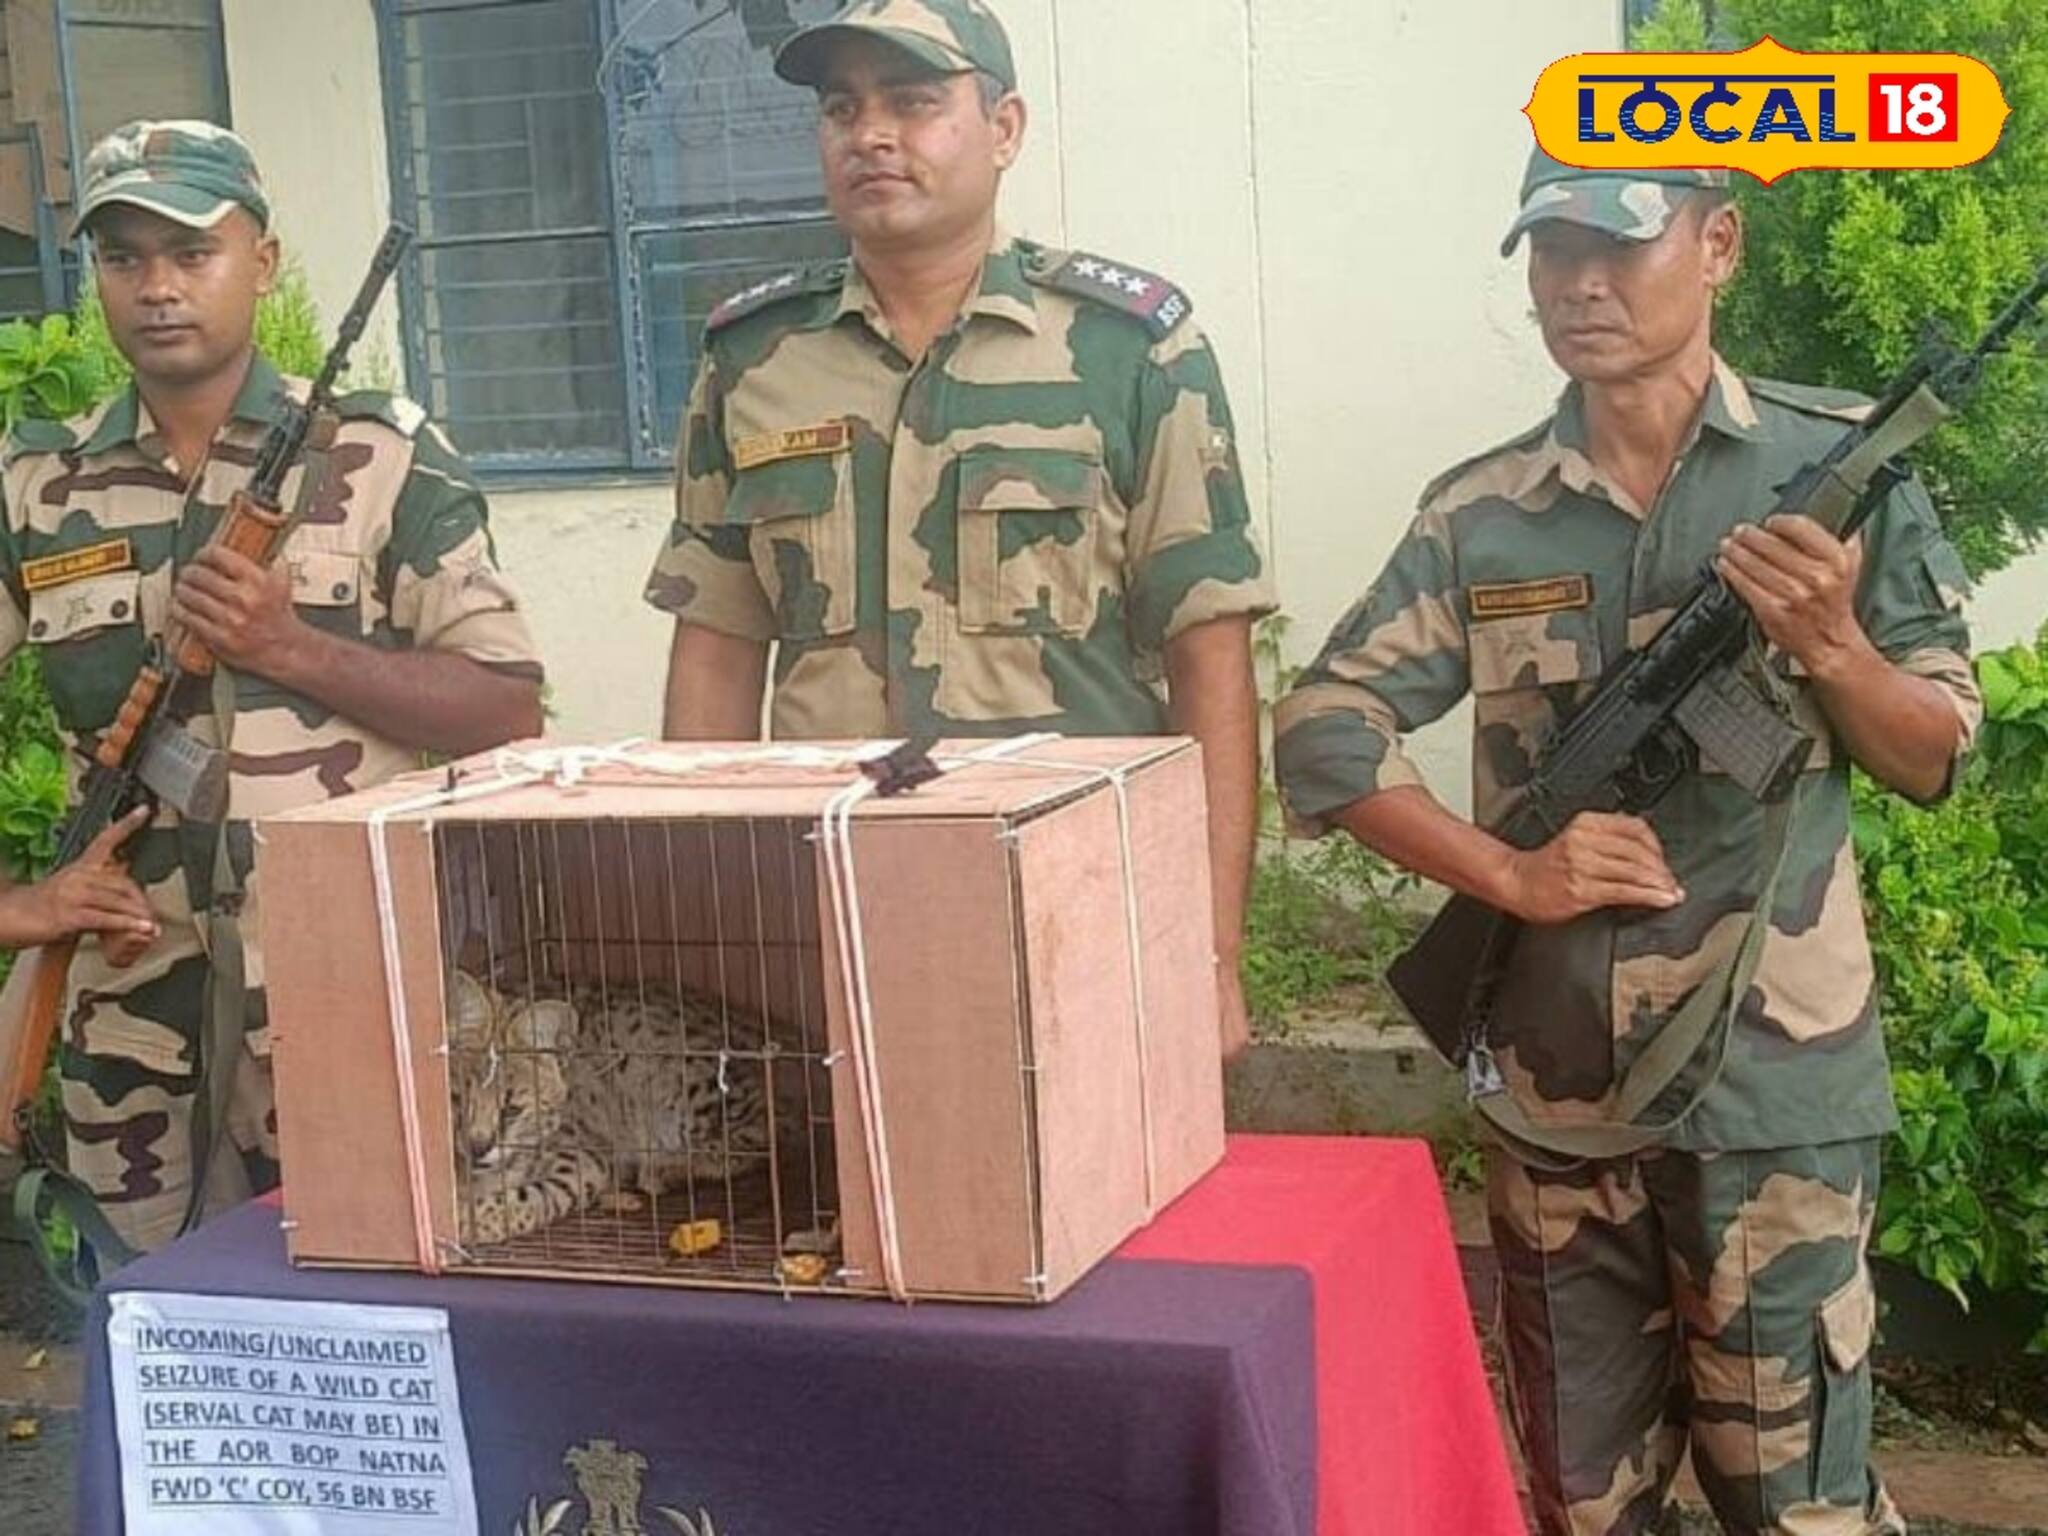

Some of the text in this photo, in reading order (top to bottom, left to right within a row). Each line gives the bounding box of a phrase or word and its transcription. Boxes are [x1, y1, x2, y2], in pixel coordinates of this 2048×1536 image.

[136, 1328, 427, 1364] INCOMING/UNCLAIMED
[139, 1364, 433, 1400] SEIZURE OF A WILD CAT
[144, 1401, 440, 1439] (SERVAL CAT MAY BE) IN
[147, 1440, 447, 1473] THE AOR BOP NATNA
[151, 1477, 212, 1501] FWD
[257, 1477, 312, 1506] COY,
[318, 1481, 346, 1504] 56
[352, 1485, 386, 1508] BN
[392, 1488, 437, 1511] BSF
